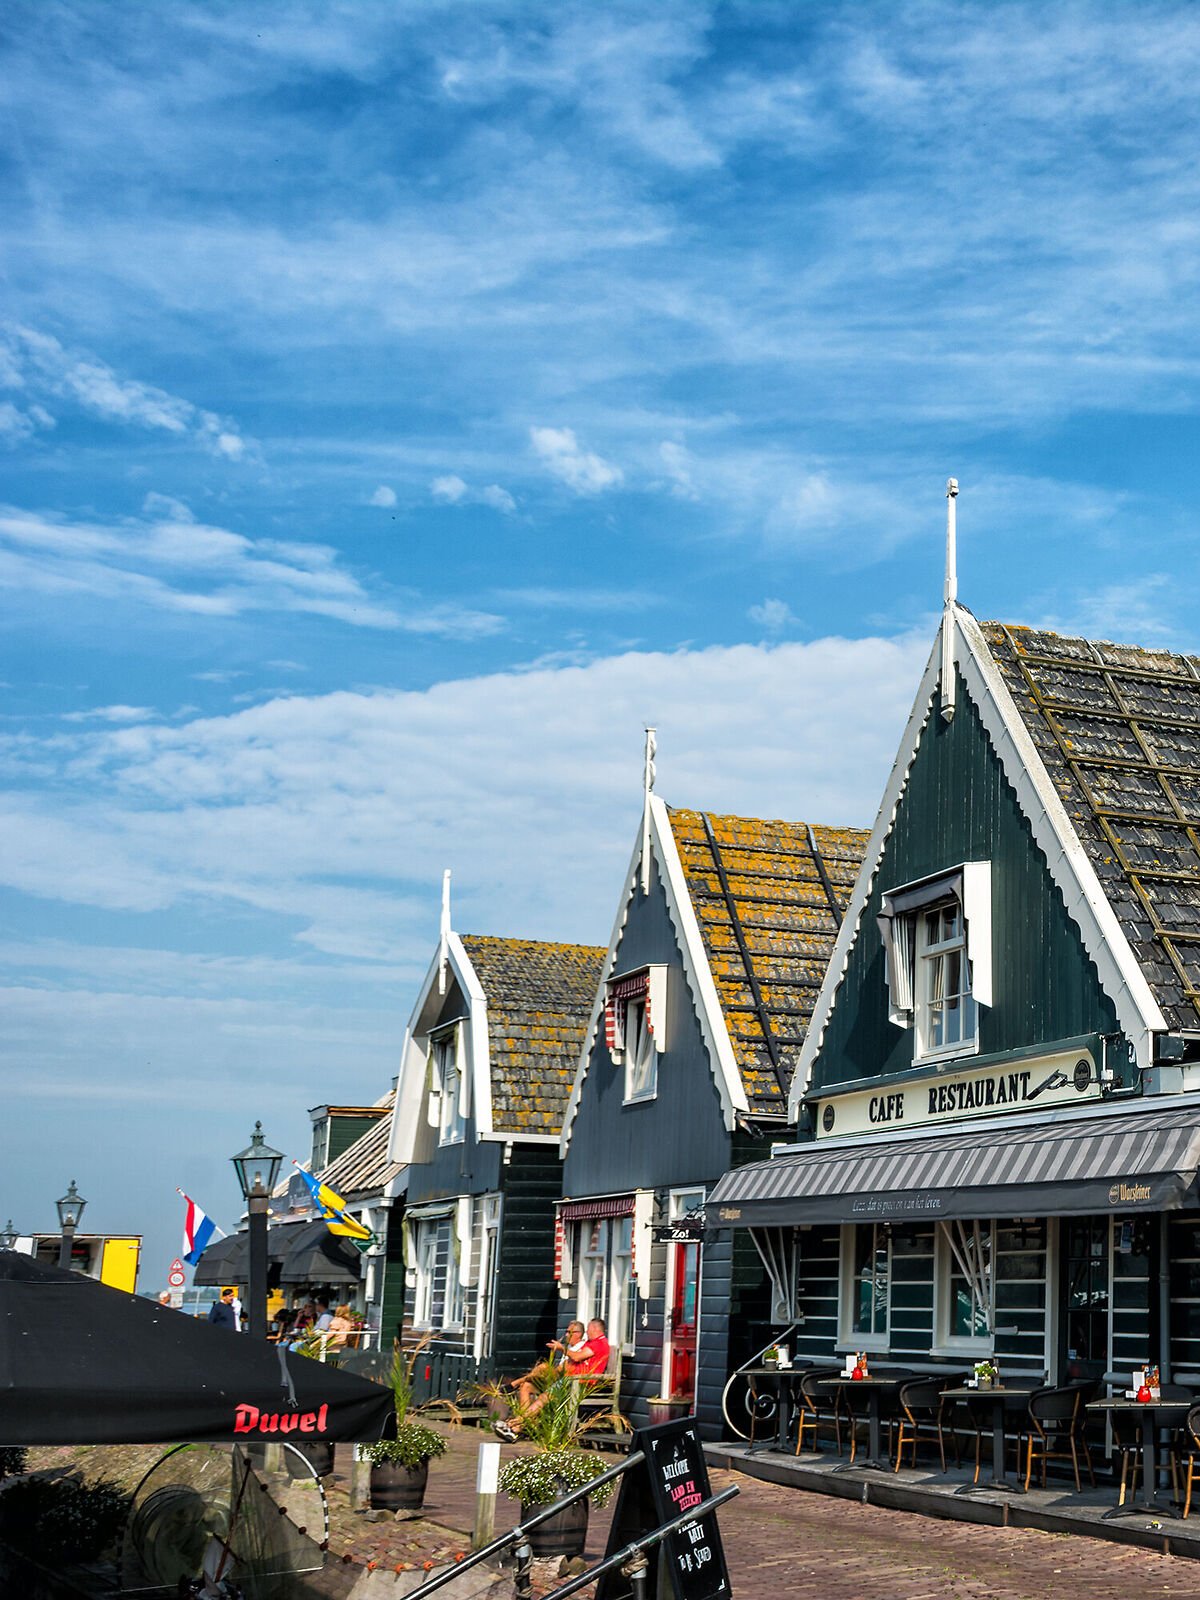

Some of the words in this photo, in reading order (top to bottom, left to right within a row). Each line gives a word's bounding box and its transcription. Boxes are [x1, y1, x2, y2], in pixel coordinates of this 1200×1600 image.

[869, 1093, 904, 1123] CAFE
[928, 1072, 1030, 1114] RESTAURANT
[1120, 1183, 1151, 1202] Warsteiner
[671, 1229, 690, 1239] Zo!
[233, 1403, 329, 1434] Duvel
[670, 1484, 685, 1502] LAND
